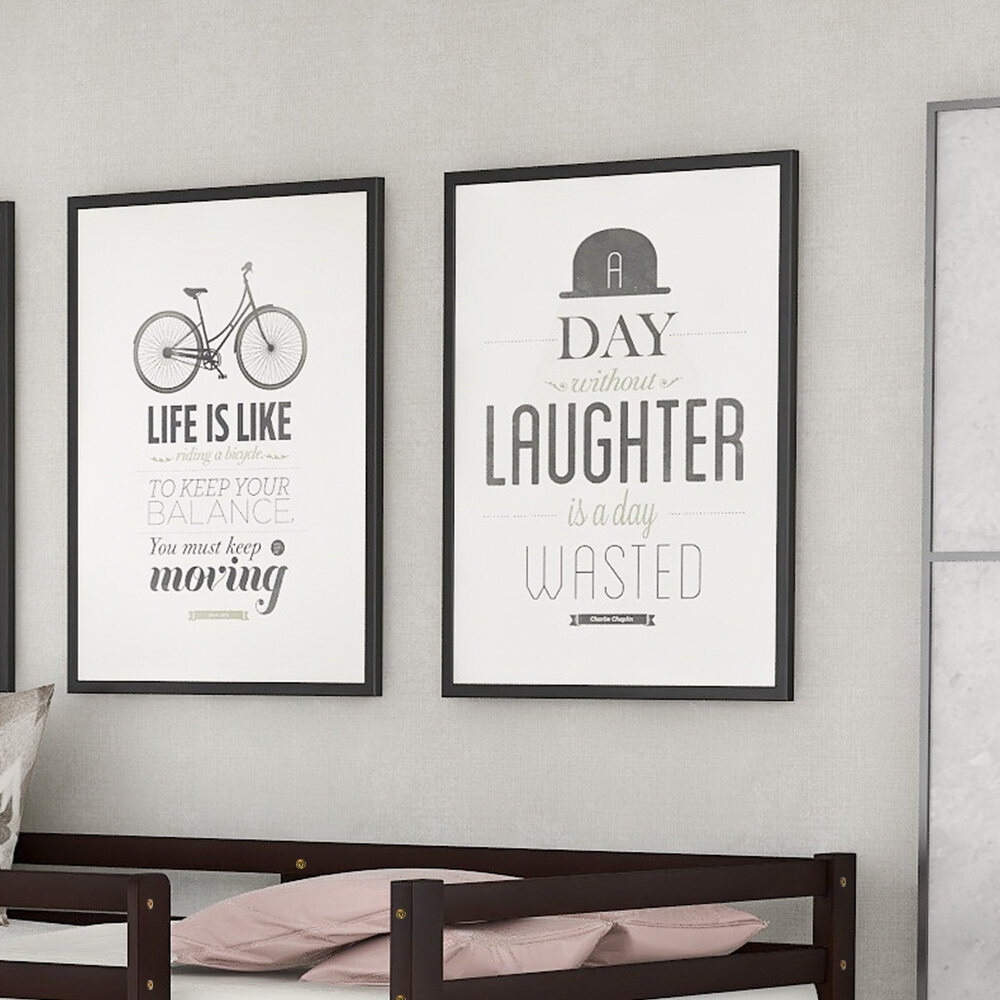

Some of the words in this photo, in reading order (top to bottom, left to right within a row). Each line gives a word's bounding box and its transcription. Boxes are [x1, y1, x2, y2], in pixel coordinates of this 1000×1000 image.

[607, 251, 623, 289] A
[557, 311, 679, 360] DAY
[570, 367, 657, 394] without
[147, 404, 198, 445] LIFE
[206, 403, 230, 443] IS
[236, 401, 292, 442] LIKE
[485, 397, 745, 487] LAUGHTER
[176, 447, 212, 466] riding
[214, 450, 223, 461] a
[149, 478, 177, 498] TO
[179, 477, 231, 498] KEEP
[235, 476, 291, 497] YOUR
[567, 497, 588, 527] is
[592, 502, 610, 527] a
[612, 488, 659, 540] day
[149, 536, 177, 555] You
[182, 541, 222, 555] must
[225, 536, 262, 562] keep
[149, 556, 289, 615] moving
[525, 543, 702, 601] WASTED
